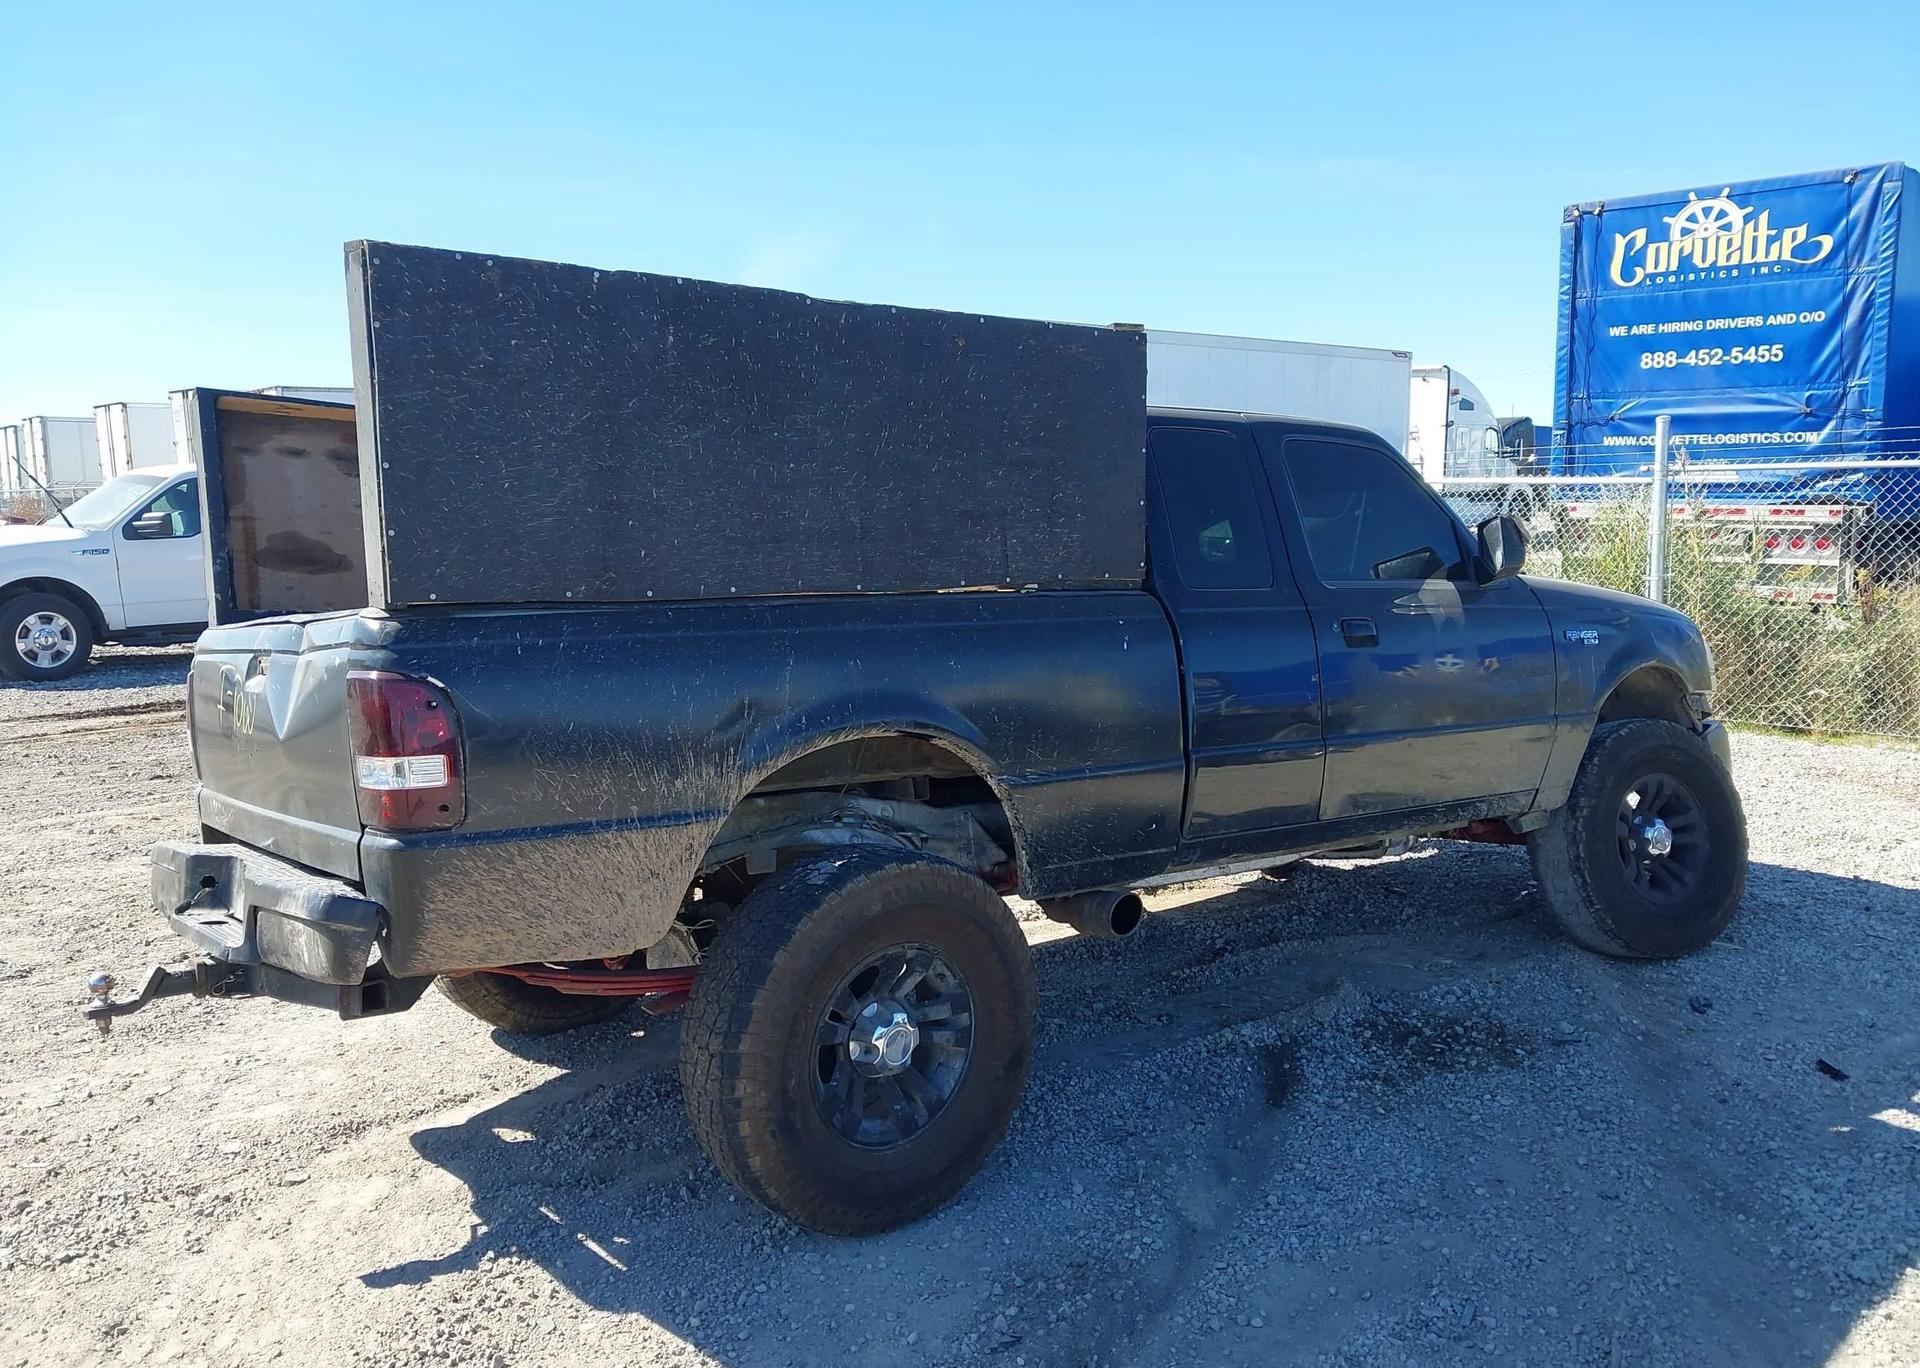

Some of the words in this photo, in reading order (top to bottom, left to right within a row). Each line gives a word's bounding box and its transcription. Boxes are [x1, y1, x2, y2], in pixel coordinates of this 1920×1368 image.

[1610, 209, 1834, 287] Corvette
[1646, 269, 1740, 285] LOGISTICS
[1751, 265, 1791, 275] INC.
[1609, 326, 1628, 337] WE
[1630, 324, 1656, 336] ARE
[1658, 320, 1703, 333] HIRING
[1706, 316, 1763, 331] DRIVERS
[1766, 313, 1796, 325] AND
[1799, 311, 1825, 323] O/O
[1640, 344, 1784, 369] 888-452-5455
[1603, 432, 1819, 446] WWW.COVETTELOGISTICS.COM
